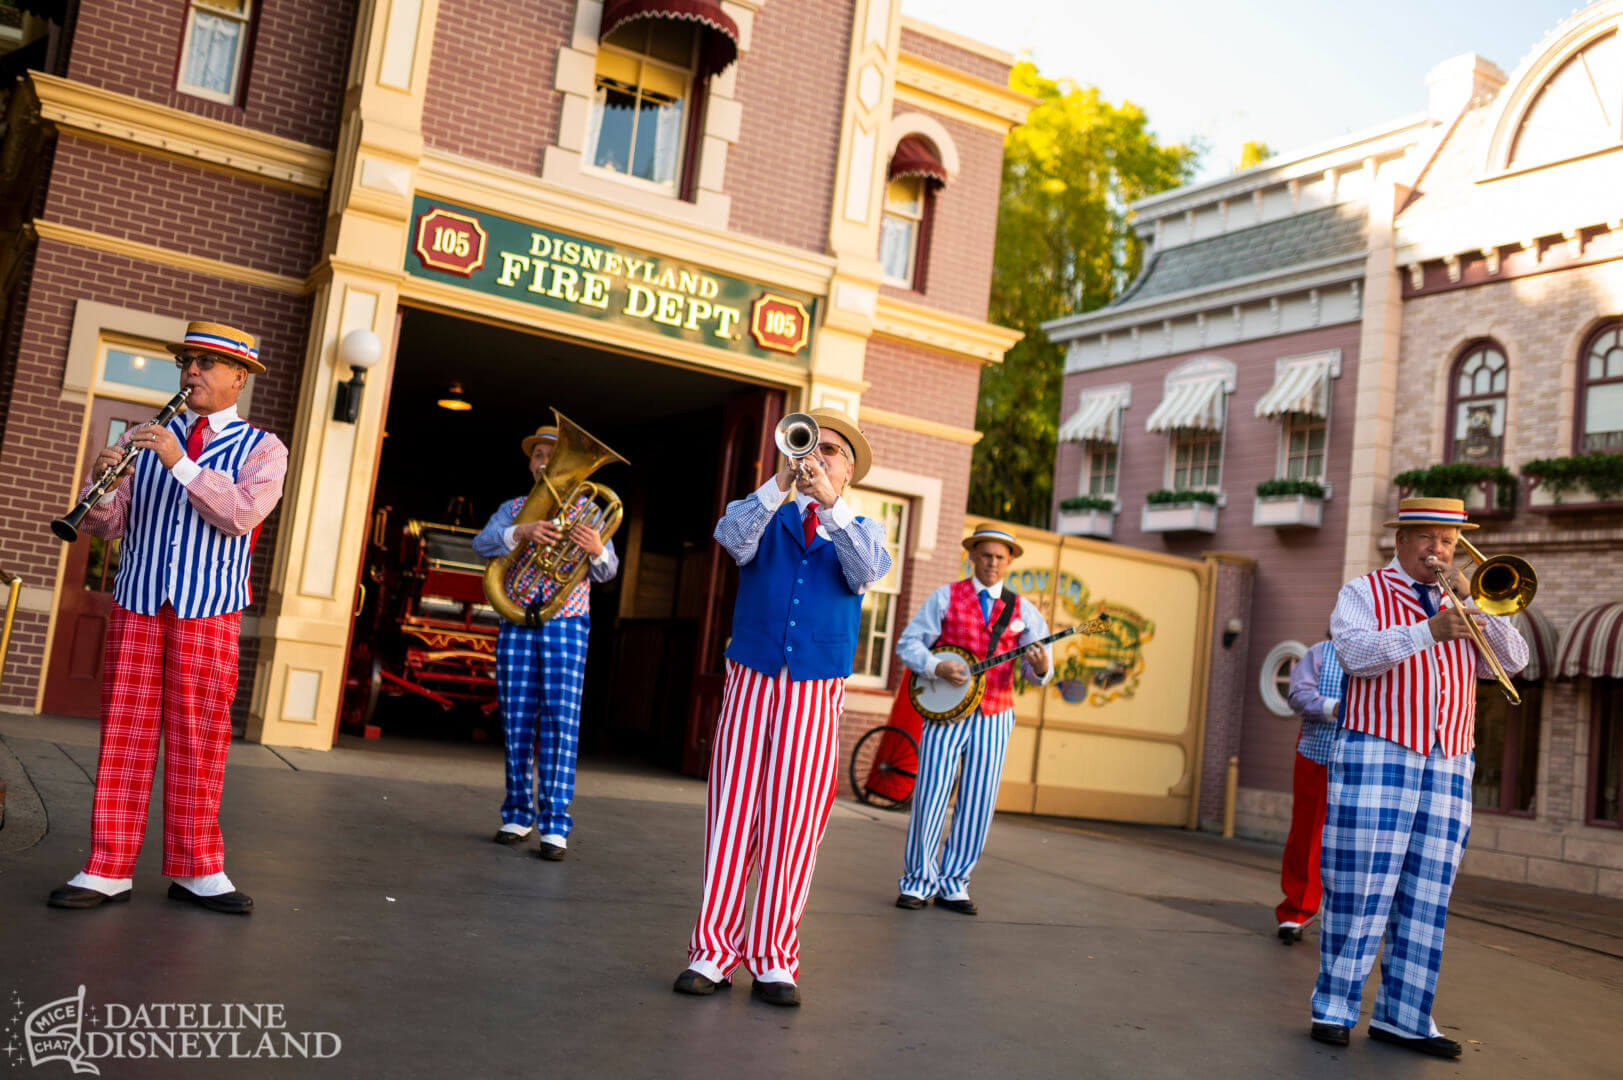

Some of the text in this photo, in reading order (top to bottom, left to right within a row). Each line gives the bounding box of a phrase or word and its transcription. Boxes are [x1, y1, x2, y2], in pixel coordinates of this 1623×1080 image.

[432, 226, 470, 257] 105
[529, 233, 719, 299] DISNEYLAND
[496, 251, 742, 341] FIRE DEPT.
[764, 309, 797, 339] 105
